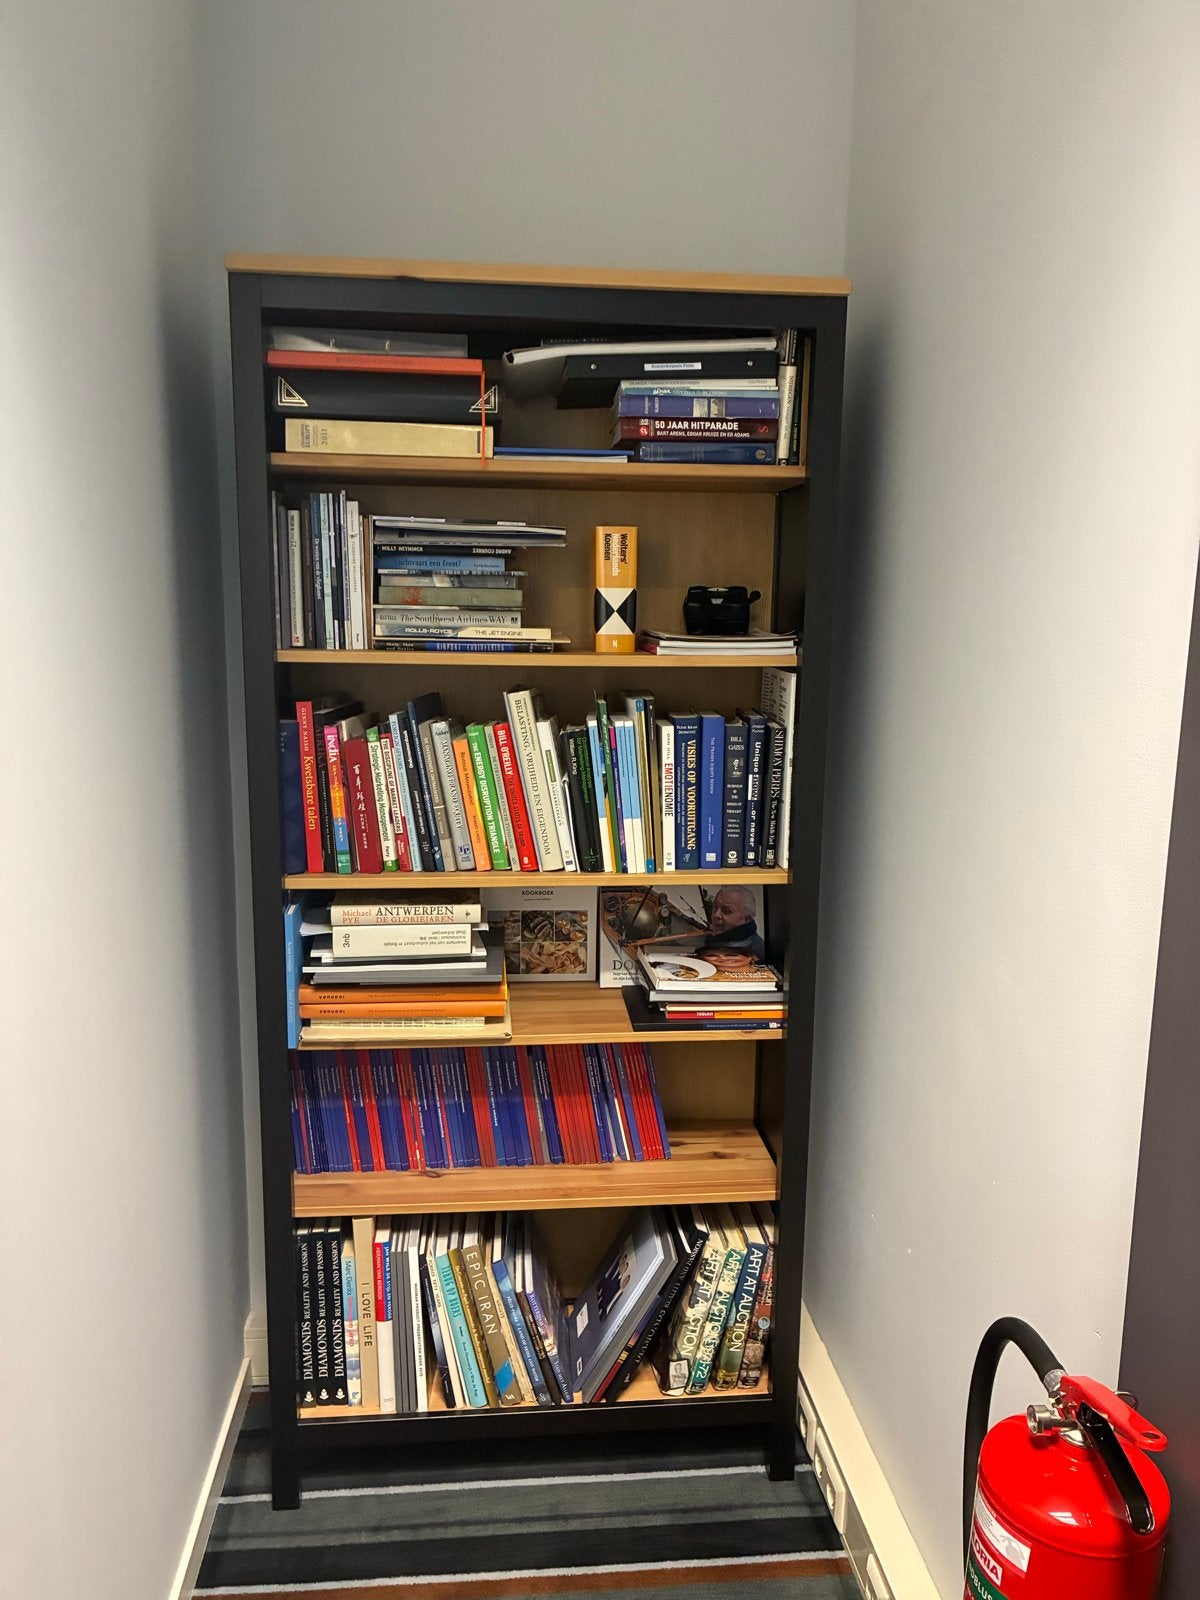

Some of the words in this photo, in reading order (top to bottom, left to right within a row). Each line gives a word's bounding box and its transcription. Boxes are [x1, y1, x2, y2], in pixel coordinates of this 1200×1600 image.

[655, 421, 667, 430] 50
[667, 421, 689, 431] JAAR
[691, 422, 739, 432] HITPARADE
[604, 533, 612, 560] Koenen
[612, 533, 620, 576] Nederlands
[620, 533, 628, 565] Wolters'
[400, 614, 414, 622] The
[414, 614, 455, 622] Southwest
[456, 614, 488, 623] Airlines
[488, 615, 506, 624] WAY
[612, 640, 618, 648] N
[391, 720, 400, 746] FOREIGN
[498, 730, 508, 746] BILL
[514, 698, 530, 751] BELASTING,
[302, 730, 310, 752] NAISH
[568, 738, 576, 757] William
[687, 739, 696, 768] VISIES
[728, 744, 744, 752] GATES
[772, 730, 784, 766] SHIMON
[370, 744, 382, 772] Strategic
[384, 752, 394, 780] DISCIPLINE
[395, 747, 404, 770] AFFAIRS
[440, 740, 454, 778] MANAGING
[500, 746, 514, 774] O'REILLY
[753, 742, 762, 772] Unique
[304, 755, 316, 806] Kwetsbare
[525, 752, 539, 792] VRIJHEID
[687, 770, 696, 783] OP
[770, 768, 781, 798] PERES
[374, 772, 386, 802] Marketing
[390, 788, 398, 809] MARKET
[448, 778, 458, 802] BRAND
[509, 788, 518, 804] UNITED
[534, 794, 542, 806] EN
[664, 762, 674, 817] EMOTIENOMIE
[452, 803, 464, 830] EQUITY
[474, 752, 486, 778] ENERGY
[480, 780, 493, 820] DISRUPTION
[488, 820, 500, 854] TRIANGLE
[512, 805, 520, 822] STATES
[307, 807, 318, 830] talen
[377, 802, 390, 842] Management
[392, 810, 402, 832] LEADERS
[537, 808, 552, 855] EIGENDOM
[687, 786, 696, 850] VOORUITGANG
[518, 830, 526, 848] TRUMP
[342, 908, 372, 917] Michael
[376, 906, 454, 917] ANTWERPEN
[391, 916, 454, 924] GLORIEJAREN
[300, 1242, 309, 1272] PASSION
[316, 1240, 324, 1270] PASSION
[331, 1240, 340, 1270] PASSION
[704, 1250, 720, 1279] ART
[724, 1252, 742, 1278] ART
[746, 1248, 764, 1276] ART
[302, 1273, 310, 1288] AND
[386, 1272, 390, 1280] DE
[441, 1266, 454, 1286] TERUG
[700, 1280, 712, 1298] AT
[744, 1276, 756, 1293] AT
[302, 1290, 311, 1320] REALITY
[318, 1288, 326, 1318] REALITY
[333, 1288, 342, 1317] REALITY
[362, 1292, 371, 1318] LOVE
[434, 1293, 442, 1308] YEARS
[446, 1288, 456, 1296] OP
[466, 1252, 486, 1290] EPIC
[479, 1295, 497, 1335] IRAN
[634, 1310, 666, 1363] DIAMONDS
[662, 1282, 682, 1308] REALITY
[679, 1266, 689, 1281] AND
[686, 1238, 704, 1266] PASSION
[449, 1299, 462, 1318] KOERS
[528, 1294, 544, 1326] ROTTERDAM
[707, 1291, 730, 1343] AUCTION
[364, 1325, 372, 1346] LIFE
[681, 1298, 709, 1356] AUCTION
[729, 1294, 753, 1352] AUCTION
[301, 1322, 314, 1380] DIAMONDS
[316, 1319, 328, 1378] DIAMONDS
[332, 1319, 344, 1378] DIAMONDS
[696, 1345, 717, 1379] 1971-72
[531, 1368, 539, 1382] WATER
